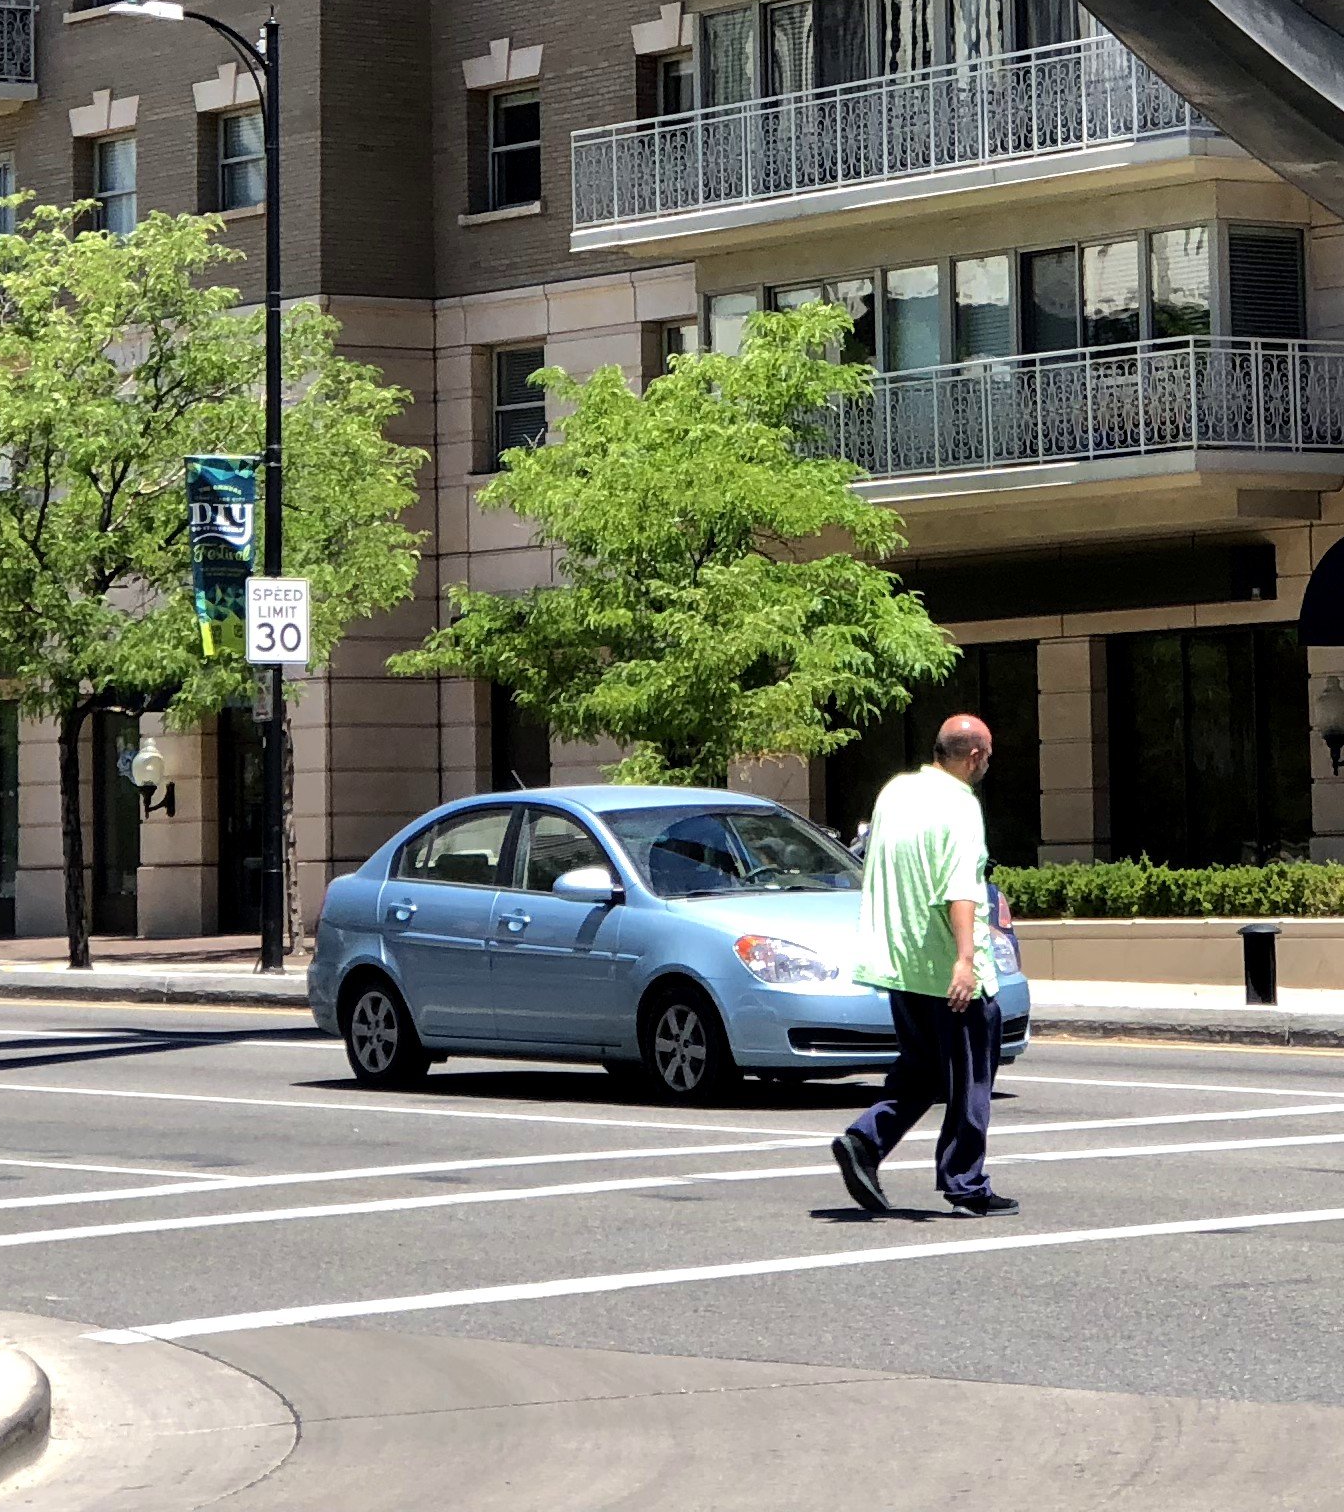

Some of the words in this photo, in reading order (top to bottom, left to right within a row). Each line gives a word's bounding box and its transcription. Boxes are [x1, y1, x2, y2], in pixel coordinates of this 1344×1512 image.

[252, 589, 303, 602] SPEED
[258, 606, 298, 619] LIMIT
[256, 622, 302, 653] 30
